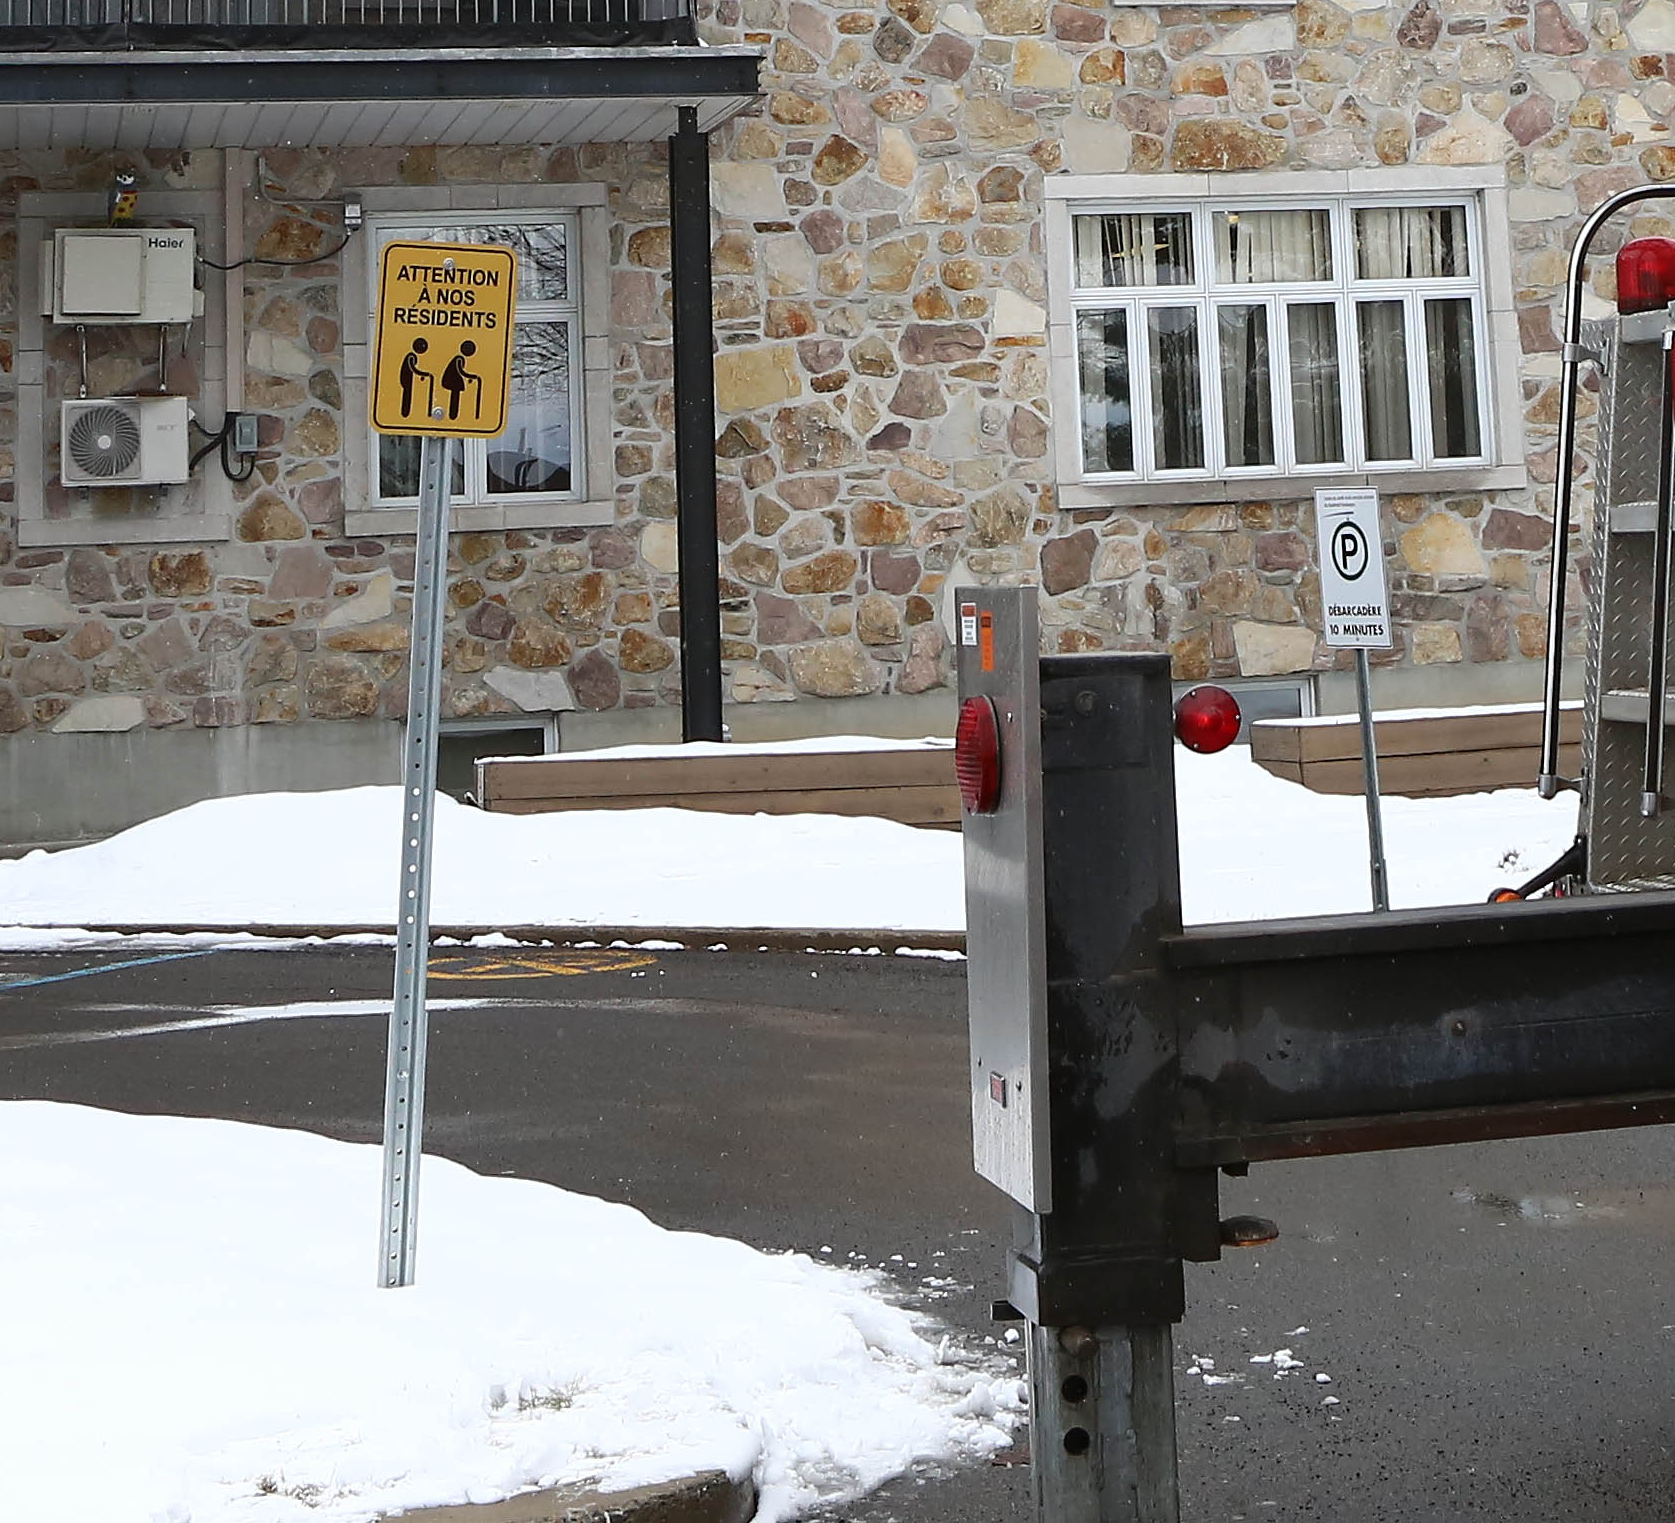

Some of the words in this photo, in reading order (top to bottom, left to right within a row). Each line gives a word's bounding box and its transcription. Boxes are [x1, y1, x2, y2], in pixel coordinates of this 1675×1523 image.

[148, 237, 184, 250] Haier
[396, 264, 500, 287] ATTENTION
[417, 283, 431, 305] À
[436, 287, 476, 307] NOS
[393, 303, 497, 329] RÉSIDENTS
[1340, 533, 1359, 570] P
[1328, 603, 1382, 617] DÉBARCADÈRE
[1329, 623, 1339, 636] 10
[1343, 623, 1385, 637] MINUTES
